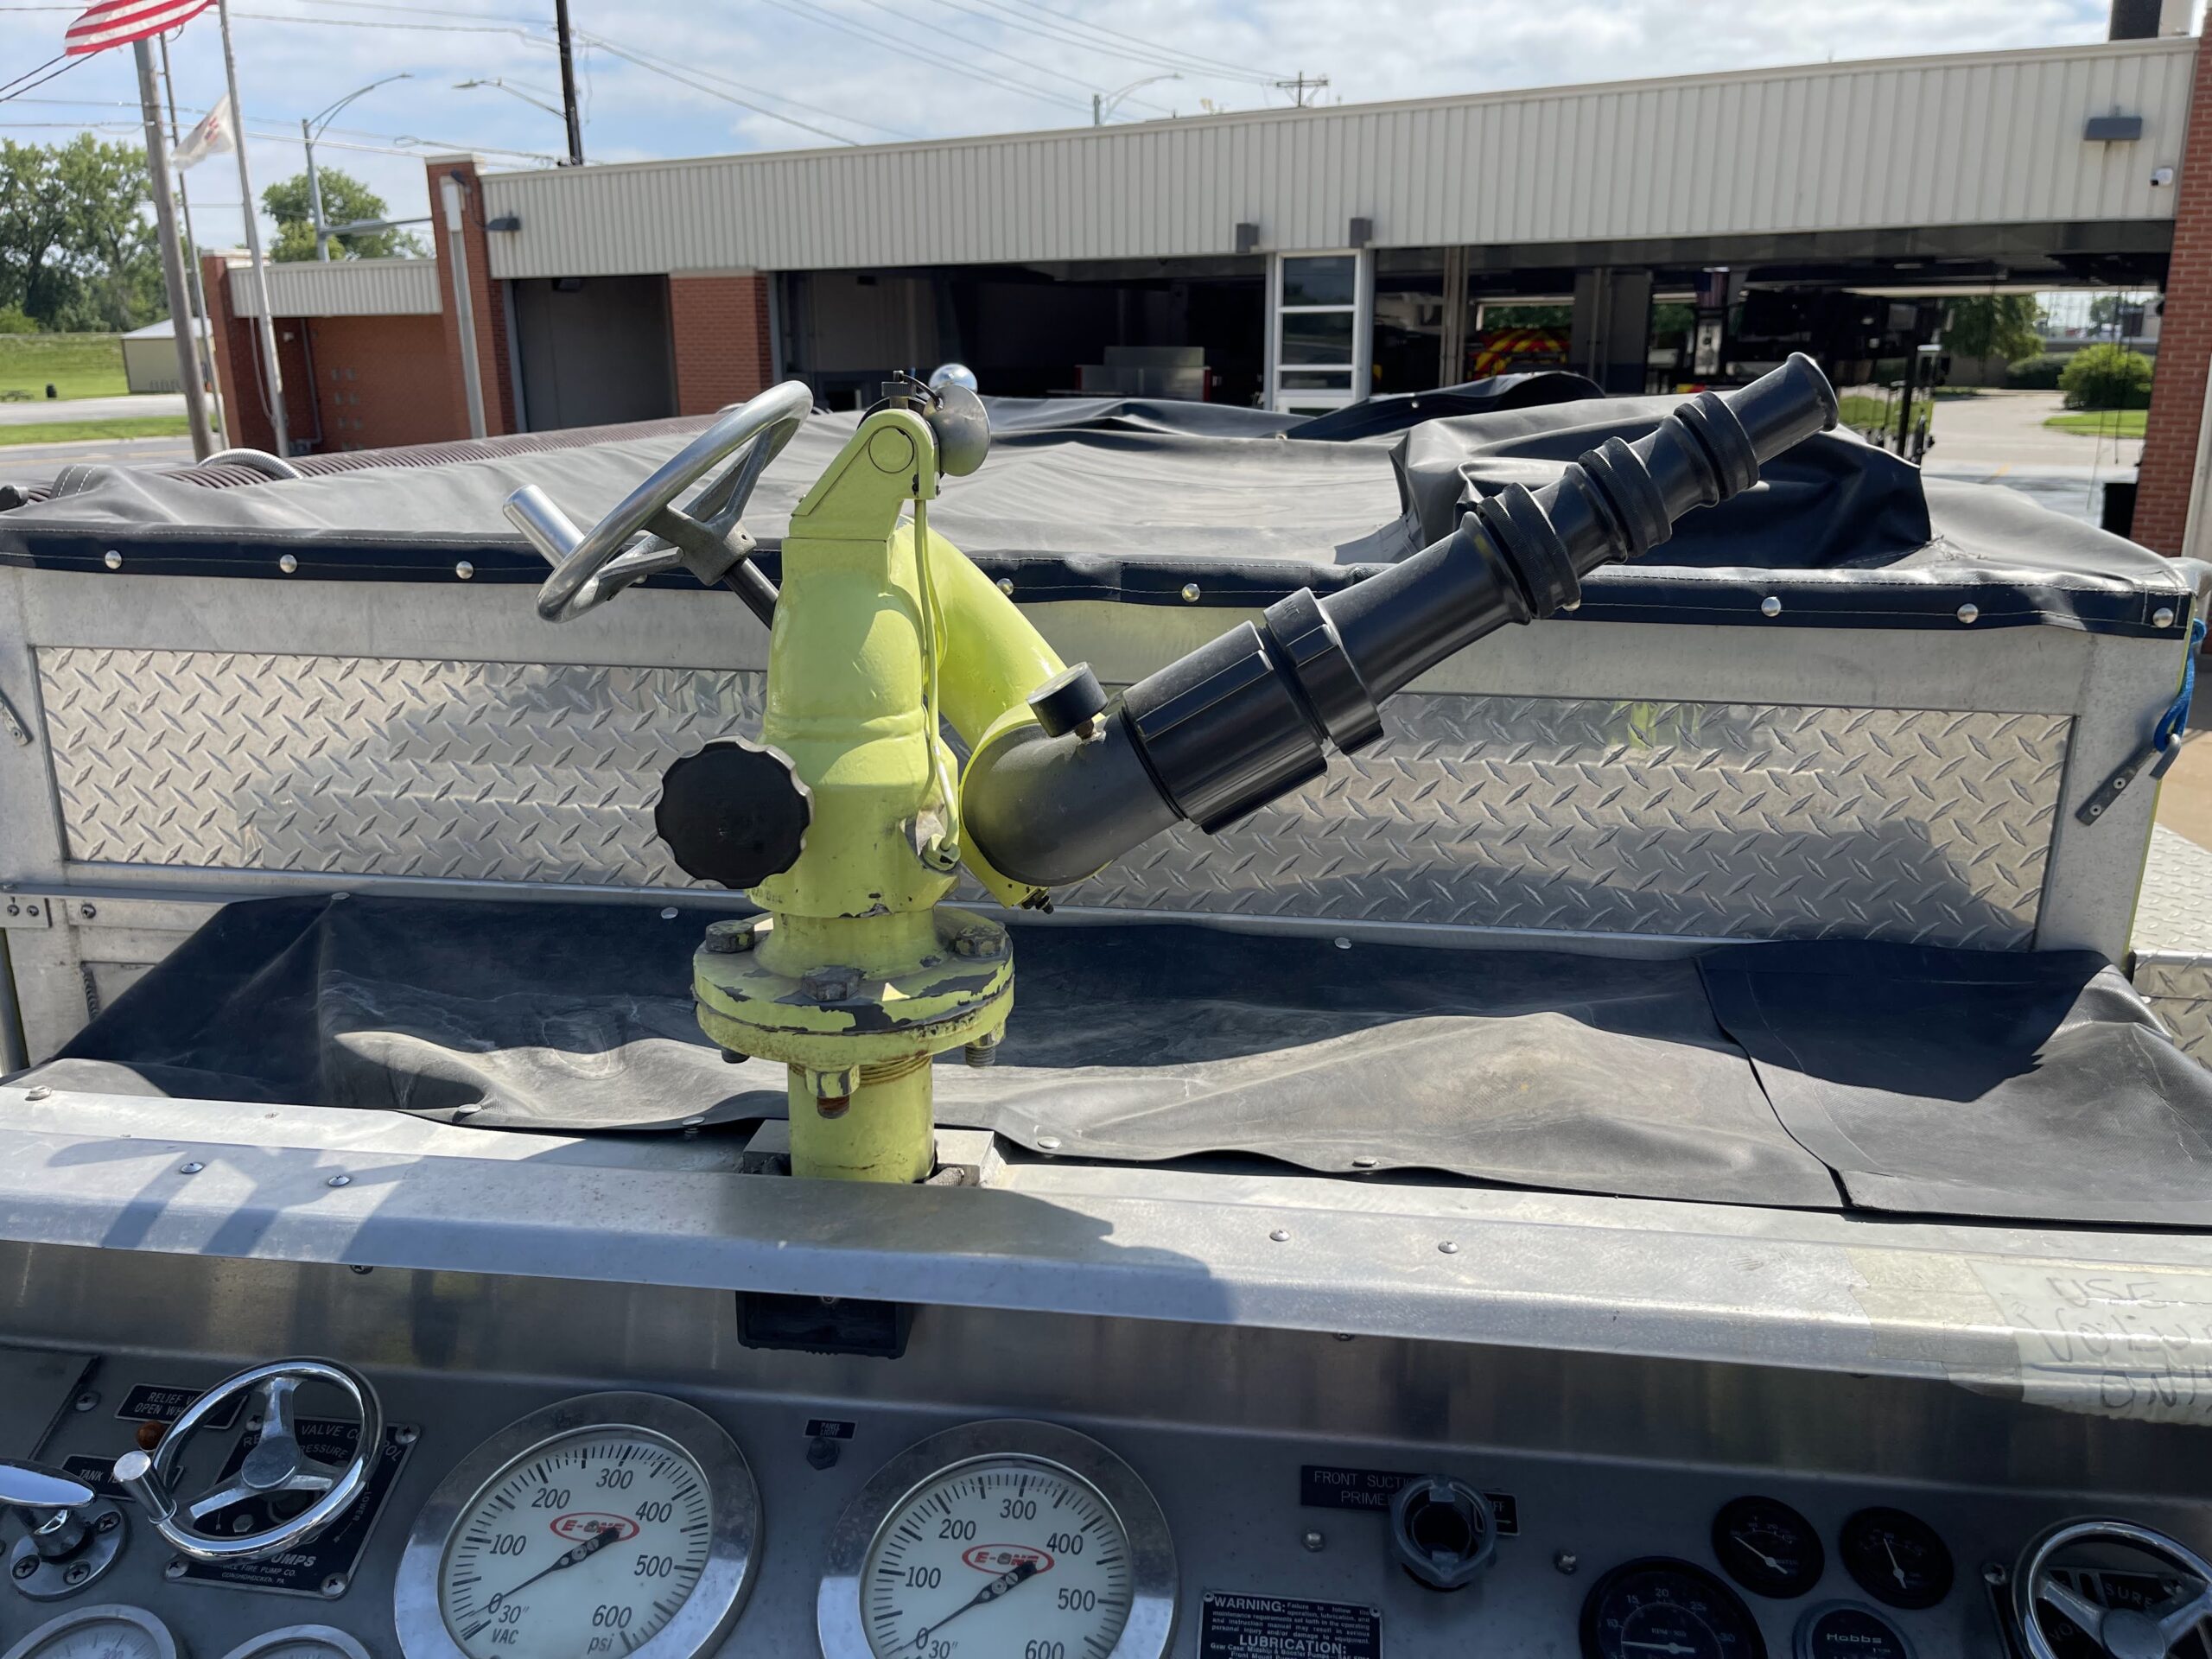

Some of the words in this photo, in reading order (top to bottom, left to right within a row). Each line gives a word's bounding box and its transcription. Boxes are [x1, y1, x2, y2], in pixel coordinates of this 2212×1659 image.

[2046, 1277, 2168, 1309] USE
[147, 1391, 182, 1405] RELIEF
[134, 1402, 162, 1415] OPEN
[302, 1424, 345, 1438] VALVE
[79, 1469, 104, 1483] TANK
[596, 1469, 633, 1490] 300
[1313, 1471, 1358, 1487] FRONT
[352, 1491, 372, 1522] LOWER
[531, 1489, 570, 1509] 200
[635, 1501, 672, 1522] 400
[1000, 1499, 1037, 1520] 300
[938, 1519, 976, 1541] 200
[489, 1535, 526, 1556] 100
[1046, 1534, 1084, 1555] 400
[271, 1553, 317, 1567] UMPS
[634, 1555, 673, 1578] 500
[905, 1567, 941, 1589] 100
[1057, 1588, 1096, 1611] 500
[1625, 1593, 1639, 1605] 15
[1654, 1586, 1669, 1598] 20
[1214, 1596, 1286, 1612] WARNING:
[592, 1605, 632, 1629] 600
[491, 1628, 518, 1645] VAC
[588, 1633, 613, 1653] psi
[1239, 1634, 1346, 1655] LUBRICATION:
[1293, 1631, 1319, 1640] damage
[1826, 1633, 1882, 1643] Hobbs
[1025, 1639, 1065, 1659] 600
